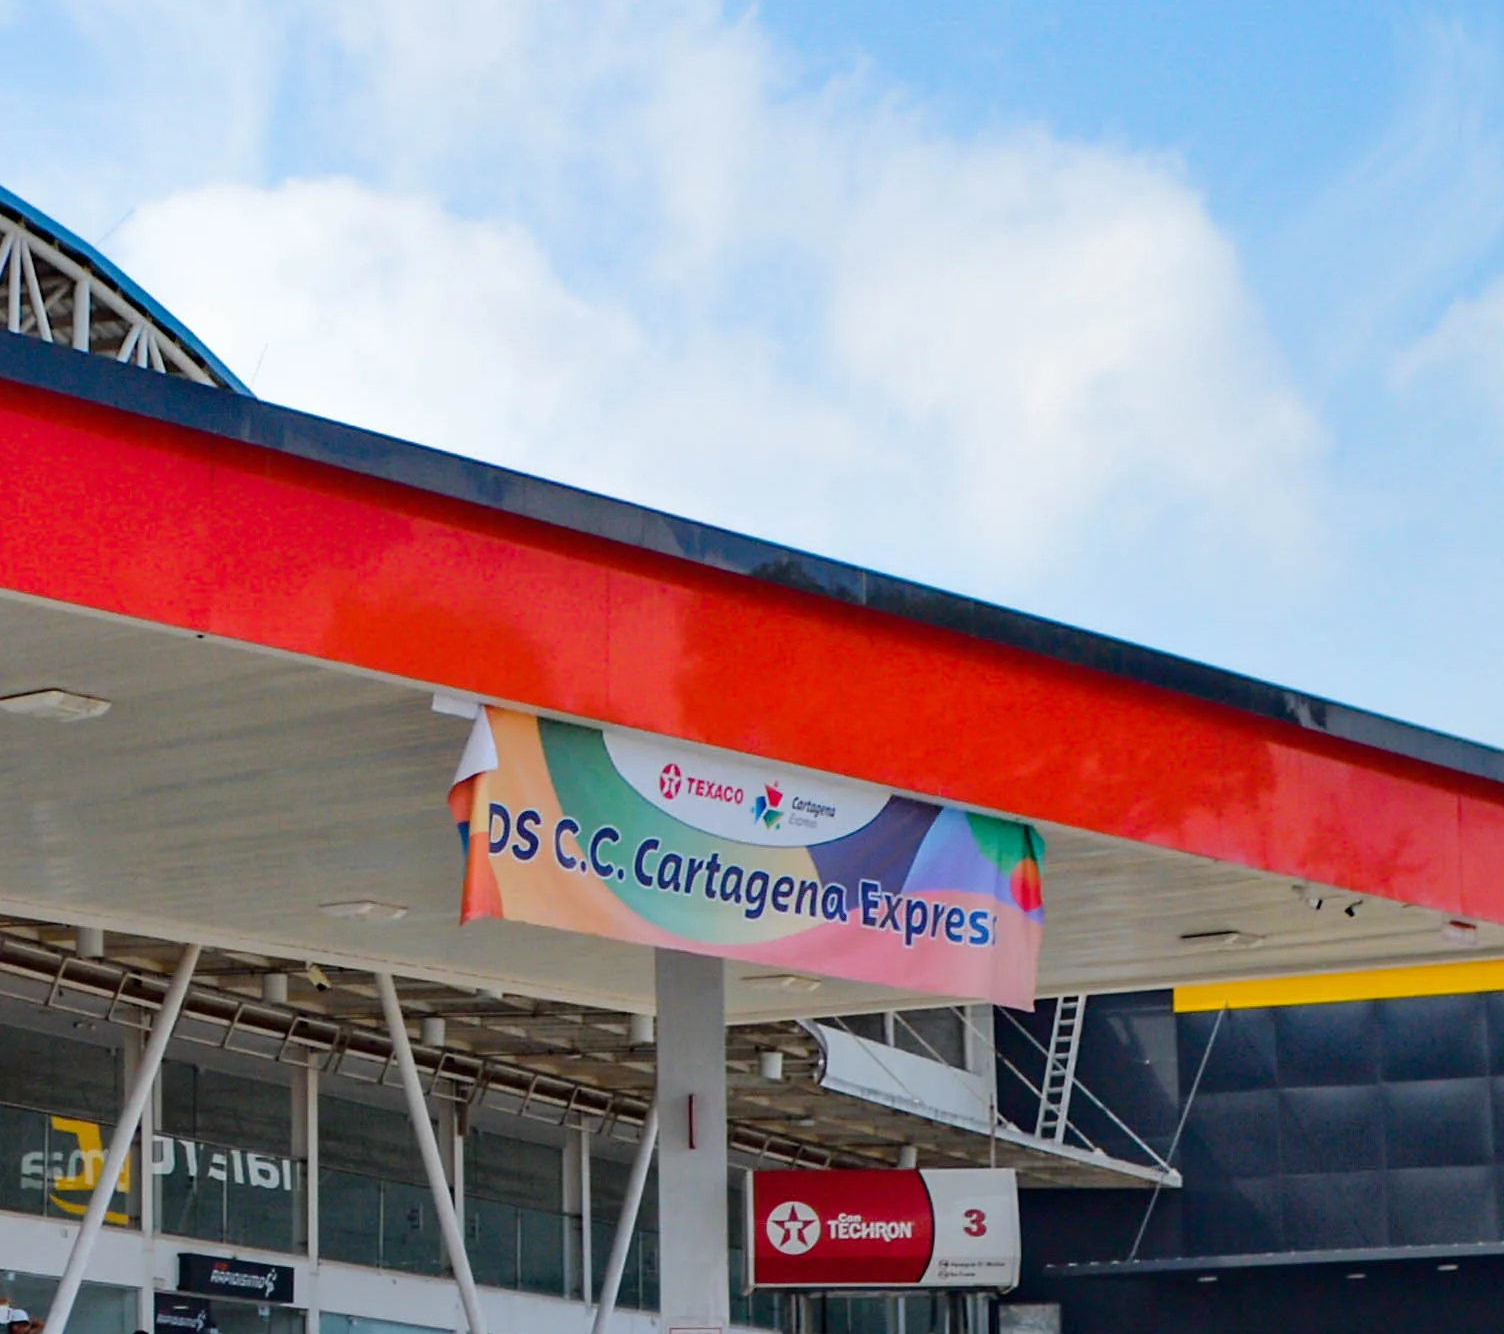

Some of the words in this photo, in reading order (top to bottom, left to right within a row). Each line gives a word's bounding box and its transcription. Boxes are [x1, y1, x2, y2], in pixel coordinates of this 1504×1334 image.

[687, 777, 745, 805] TEXACO
[791, 795, 837, 819] Cartagena
[553, 817, 623, 880] C.C.
[633, 837, 849, 924] Cartagena
[828, 1221, 913, 1242] TECHRON
[963, 1208, 987, 1237] 3
